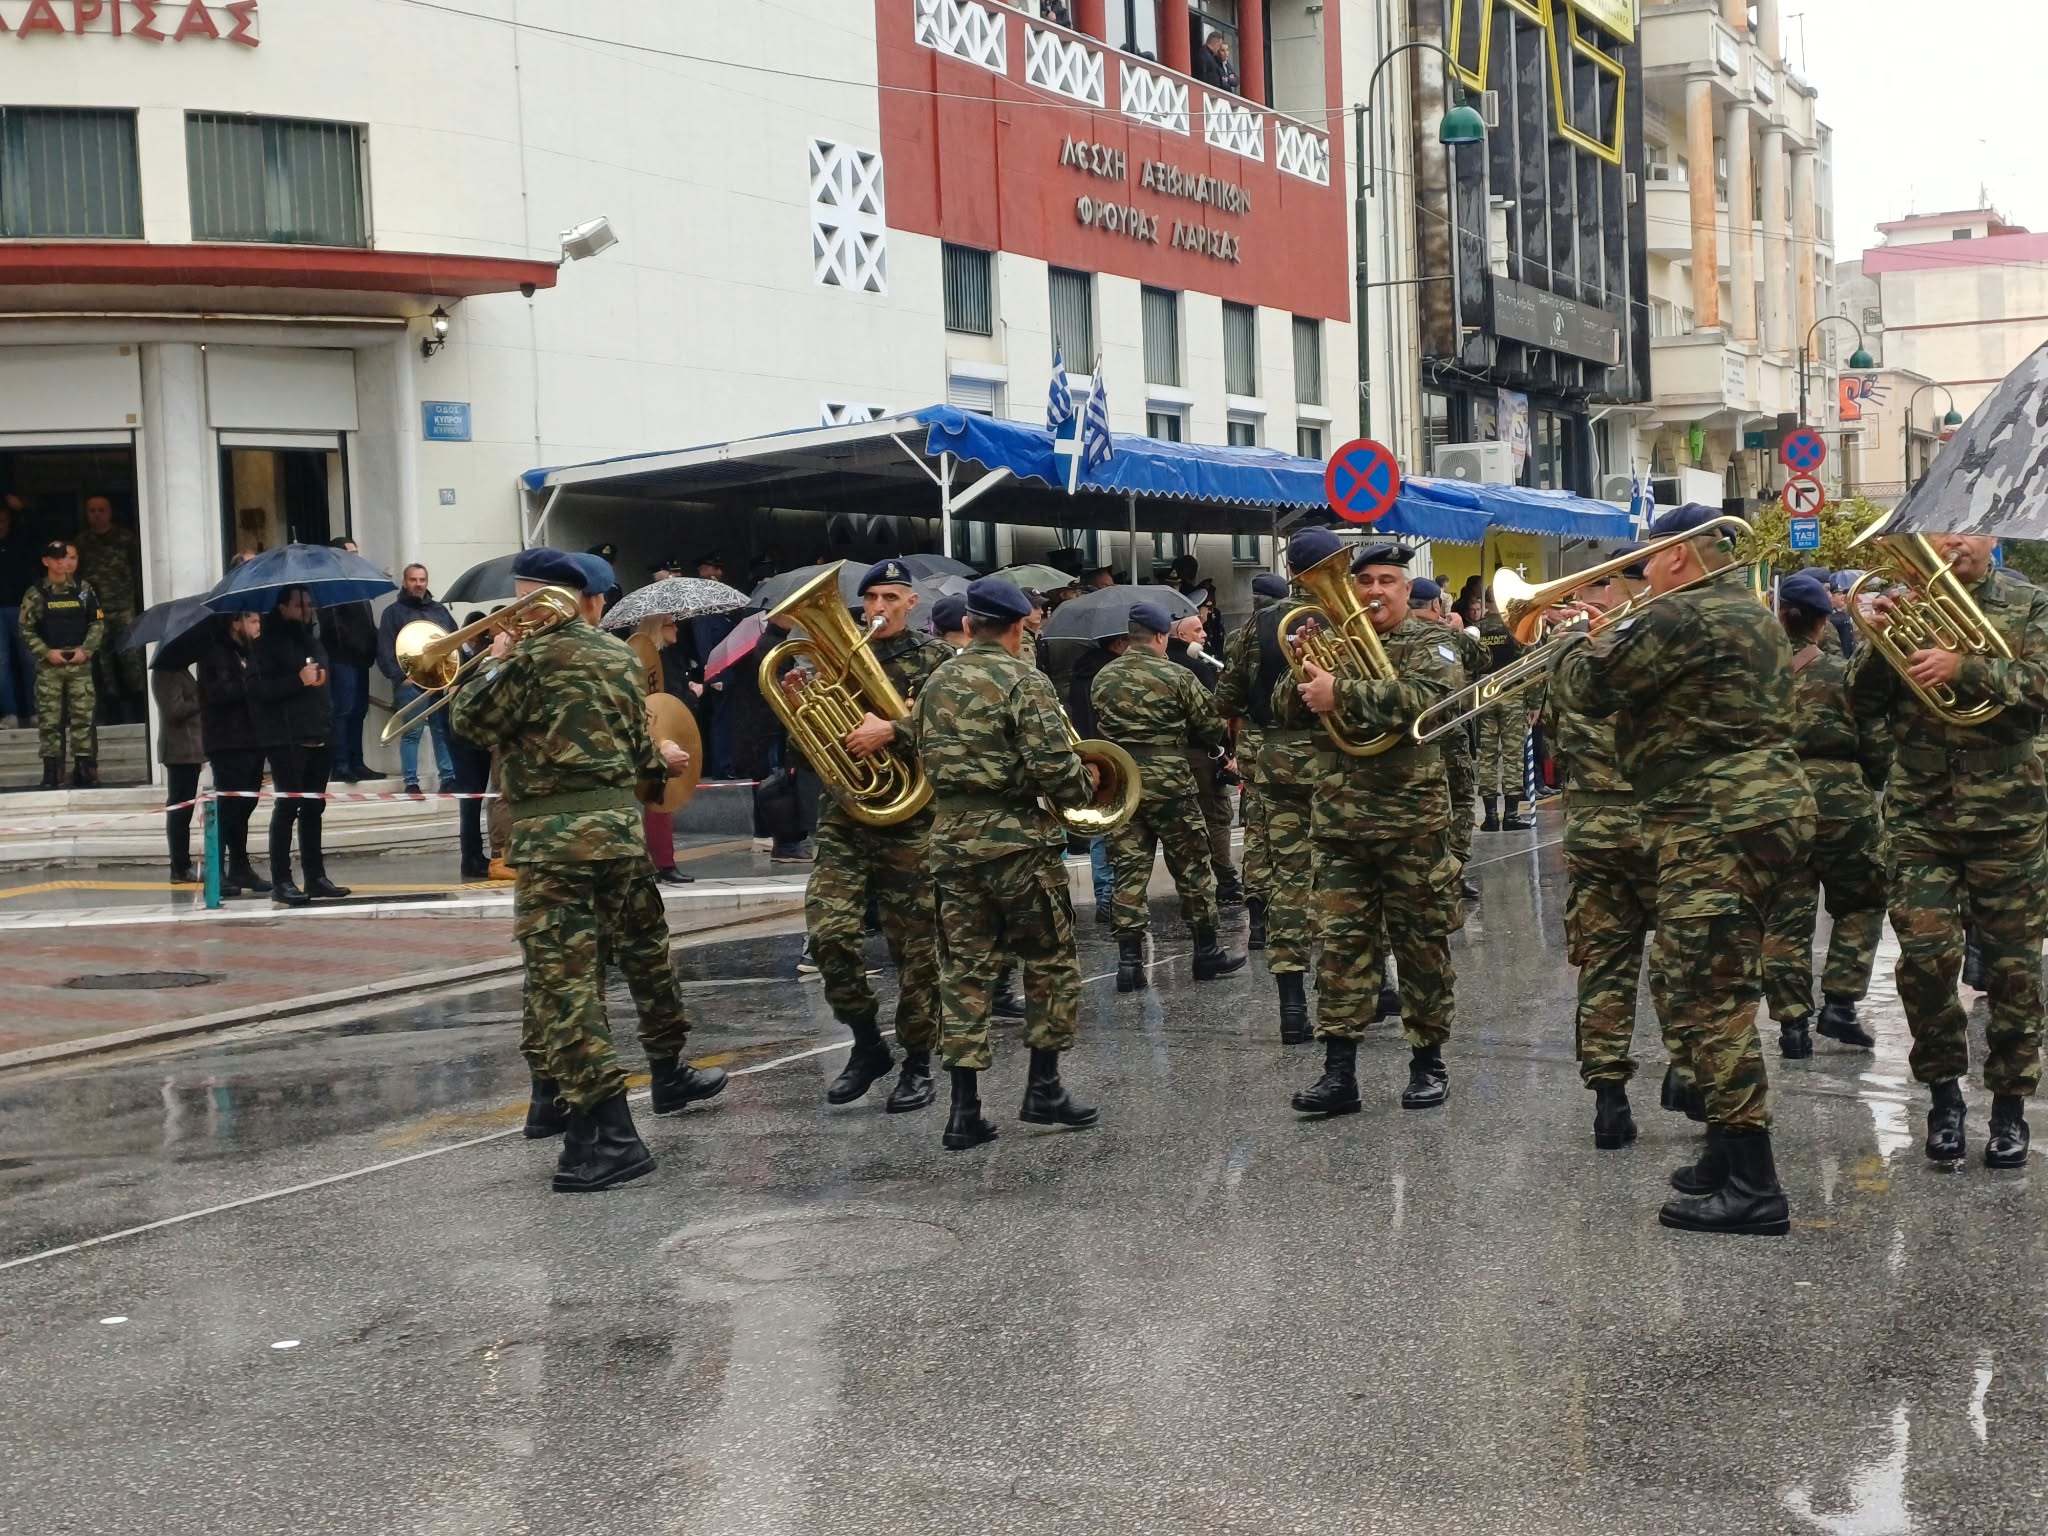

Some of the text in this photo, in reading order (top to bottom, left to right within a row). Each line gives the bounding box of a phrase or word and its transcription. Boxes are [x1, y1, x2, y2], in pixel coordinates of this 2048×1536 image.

[0, 0, 260, 47] ΑΡΙΣΑΣ
[1060, 133, 1251, 217] ΛΕΣΧΗ ΑΞΙΩΜΑΤΙΚΩΝ
[1076, 194, 1241, 264] ΦΡΟΥΡΑΣ ΛΑΡΙΣΑΣ
